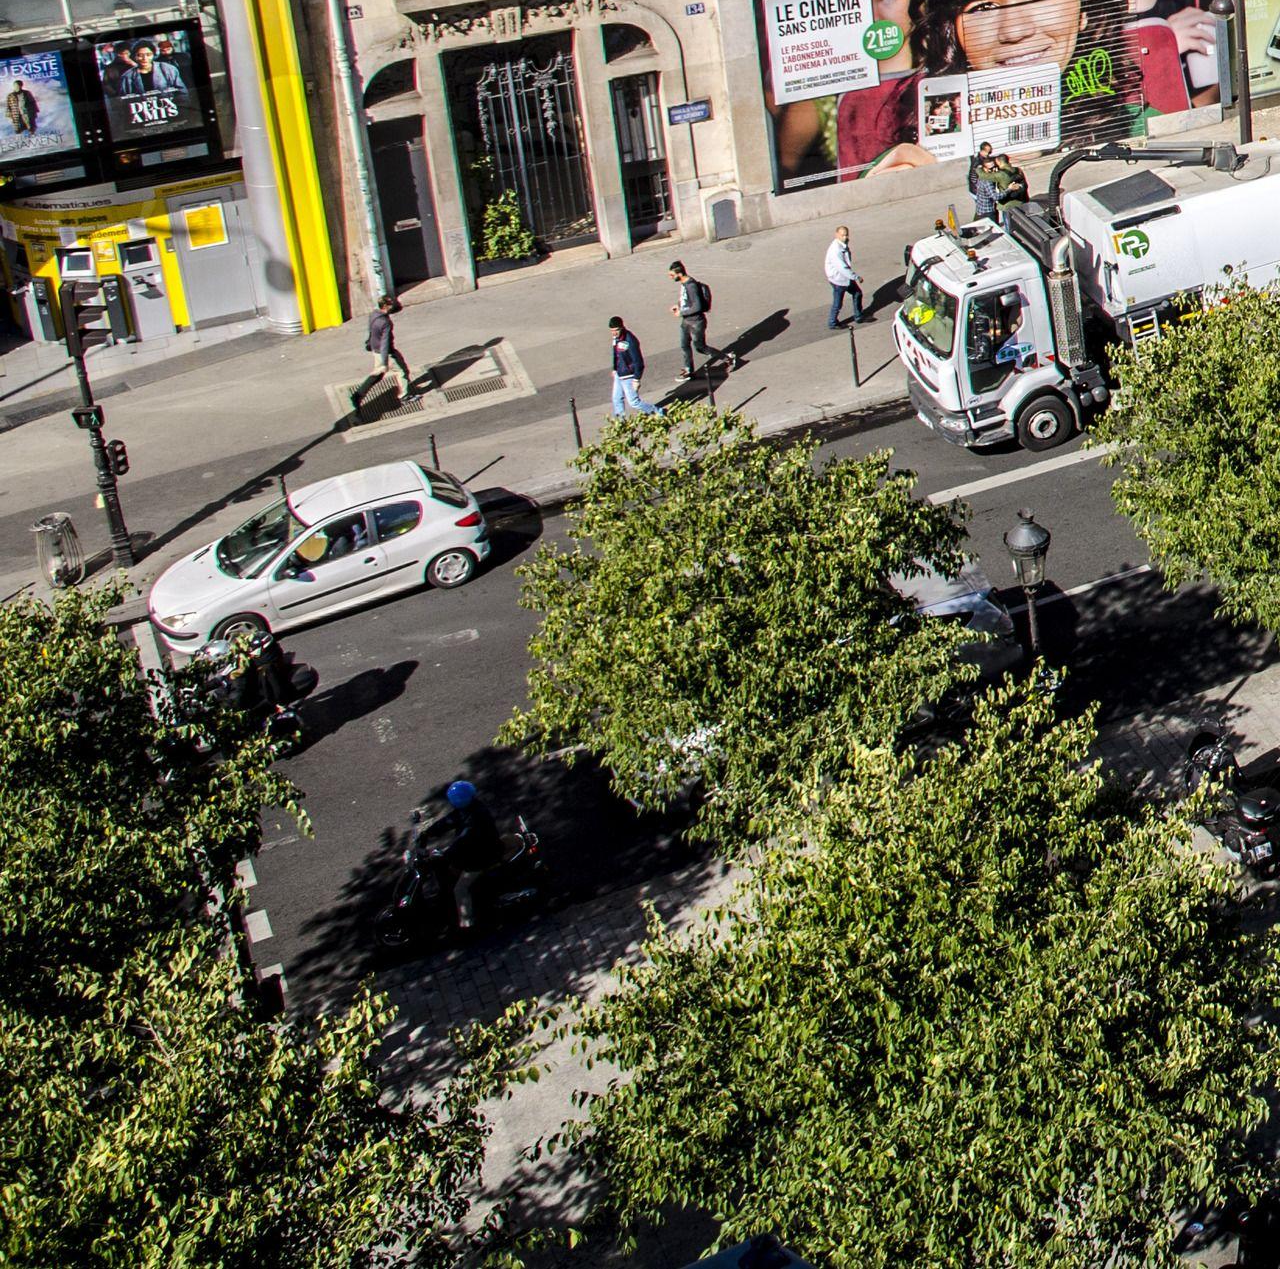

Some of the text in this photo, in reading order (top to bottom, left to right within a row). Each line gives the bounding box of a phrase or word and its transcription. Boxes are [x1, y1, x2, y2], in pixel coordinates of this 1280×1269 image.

[775, 4, 794, 22] LE
[778, 12, 862, 37] SANS COMPTER
[781, 39, 831, 55] LE PASS SOLO,
[782, 48, 834, 64] L'ABONNEMENT
[11, 59, 58, 76] EXISTE
[783, 53, 861, 74] AU CINEMA A VOLONTE.
[130, 96, 174, 115] DEUX
[968, 89, 1015, 105] GAUMONT
[131, 105, 178, 124] AMIS
[968, 100, 1053, 124] LE PASS SOLO
[1, 134, 64, 152] ESTAMENT
[23, 198, 112, 210] Automatiques
[77, 229, 127, 240] rapidemen
